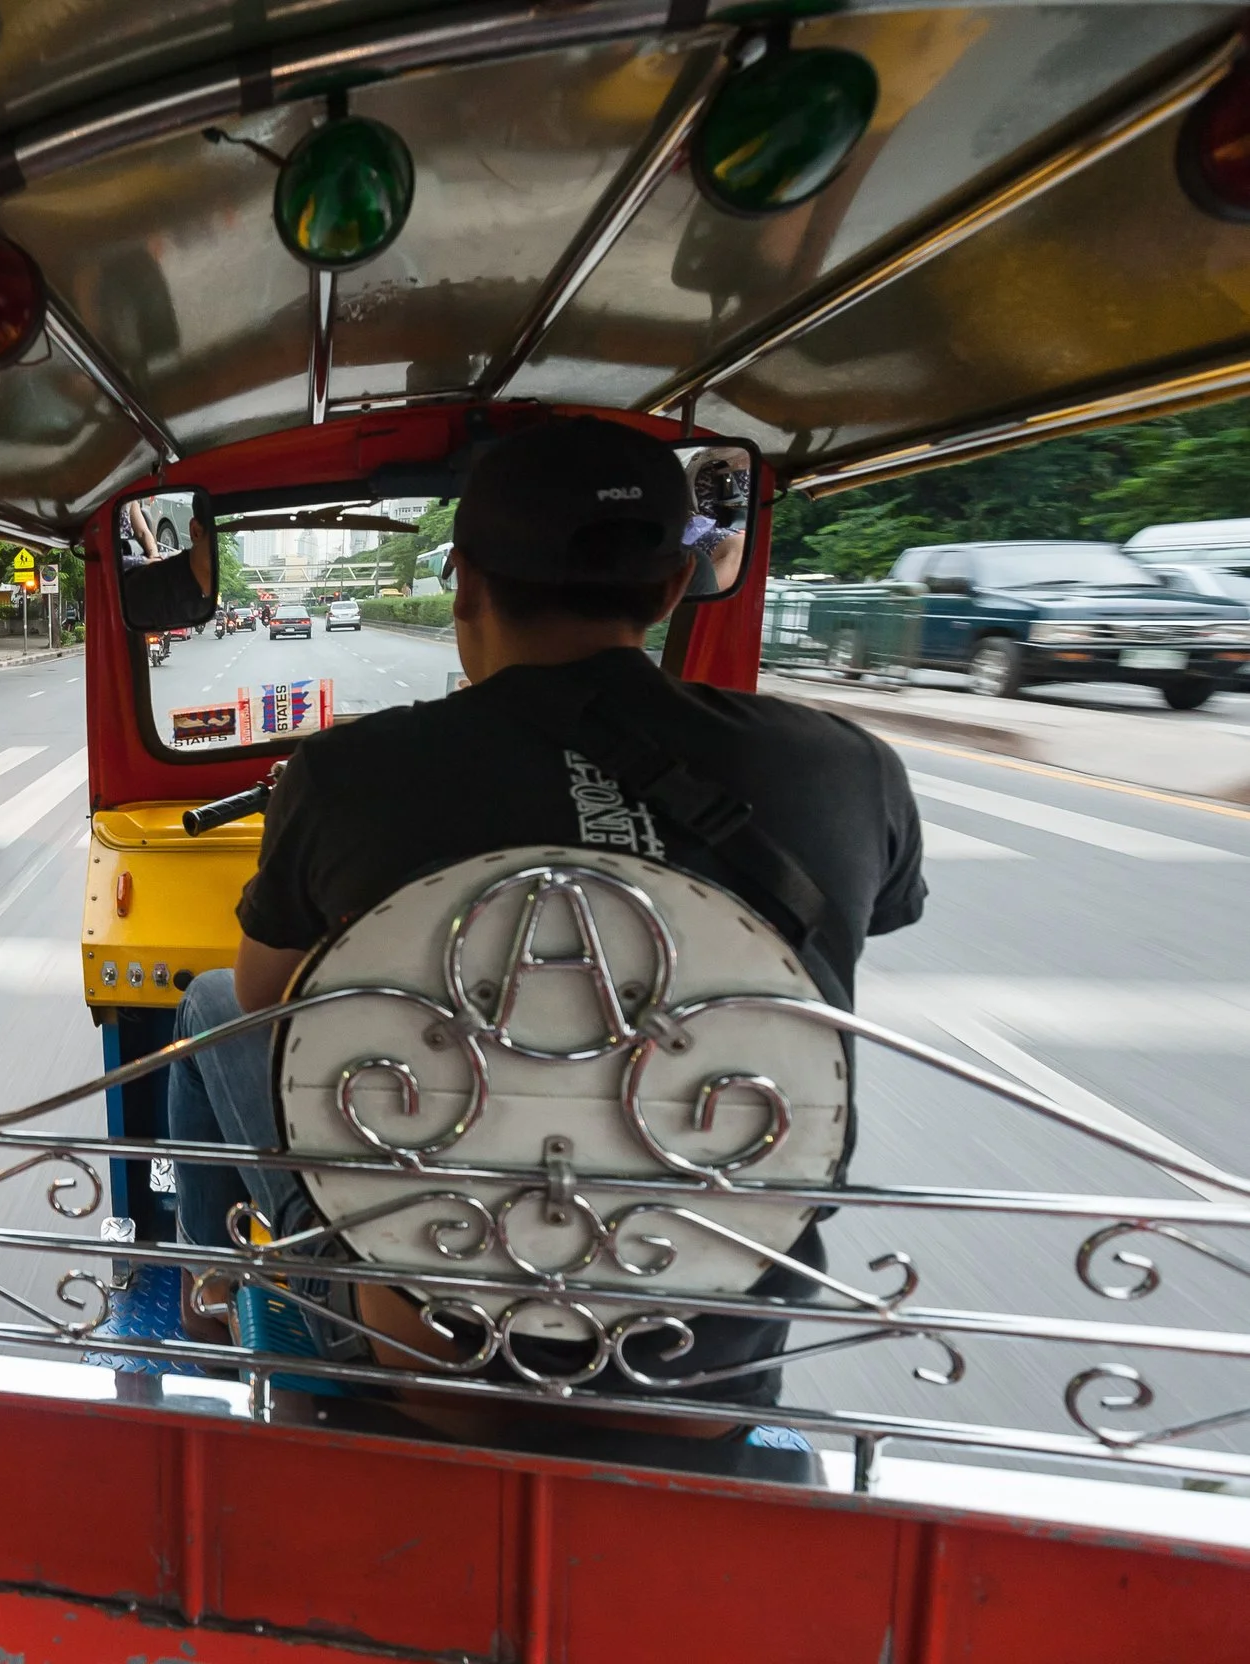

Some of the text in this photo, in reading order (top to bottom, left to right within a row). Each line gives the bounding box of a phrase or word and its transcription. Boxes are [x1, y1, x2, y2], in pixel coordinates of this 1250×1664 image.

[596, 486, 643, 501] POLO
[276, 685, 289, 732] STATES
[174, 735, 228, 748] STATES
